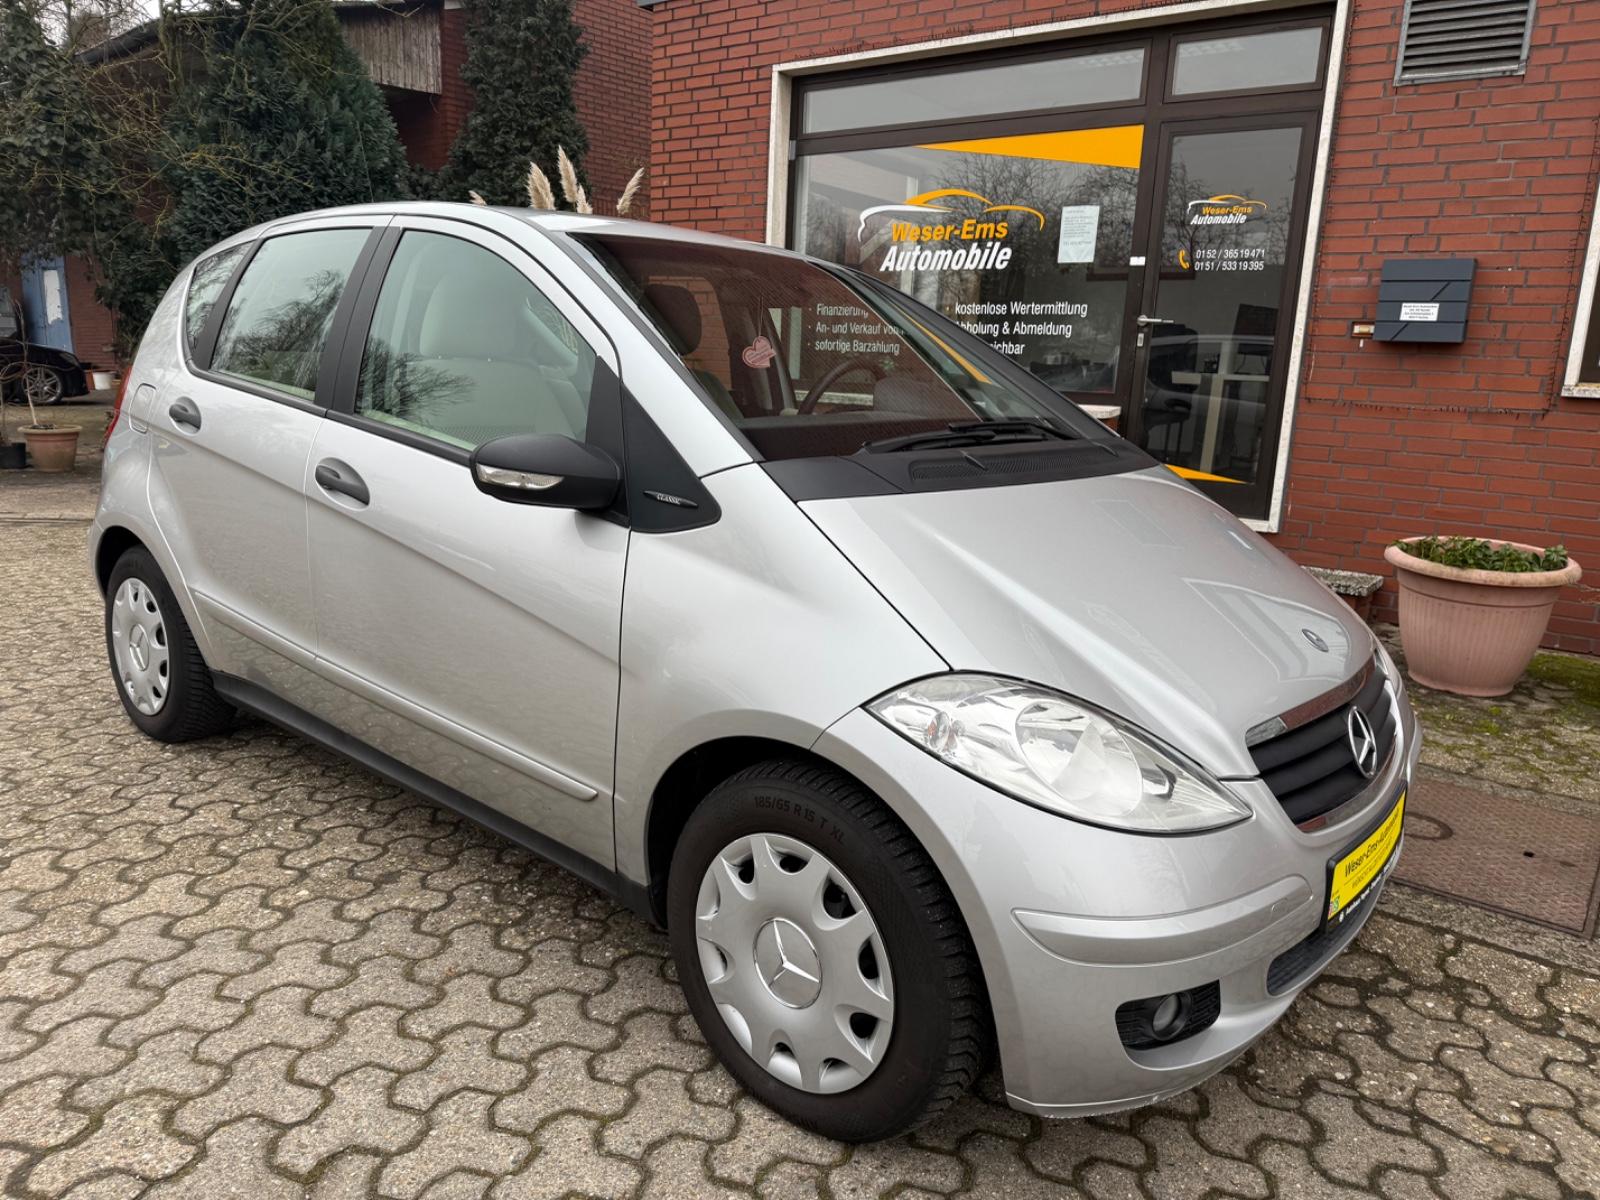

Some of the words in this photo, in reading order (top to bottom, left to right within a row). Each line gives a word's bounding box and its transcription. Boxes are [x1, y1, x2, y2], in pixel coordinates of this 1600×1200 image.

[1190, 213, 1247, 224] Automobile
[1202, 205, 1253, 215] Weser-Ems
[891, 218, 1009, 242] Weser-Ems
[879, 241, 1012, 272] Automobile
[955, 301, 1007, 316] kostenlose
[1010, 300, 1088, 318] Wertermittlung
[816, 321, 830, 333] An-
[832, 323, 848, 335] und
[849, 322, 881, 336] Verkauf
[957, 321, 999, 337] bholung
[1002, 321, 1010, 335] &
[1012, 321, 1073, 338] Abmeldung
[815, 338, 851, 354] sofortige
[853, 340, 900, 357] Barzahlung
[754, 795, 791, 812] 185/65
[793, 803, 802, 817] R
[804, 807, 816, 823] 15
[820, 816, 829, 830] T
